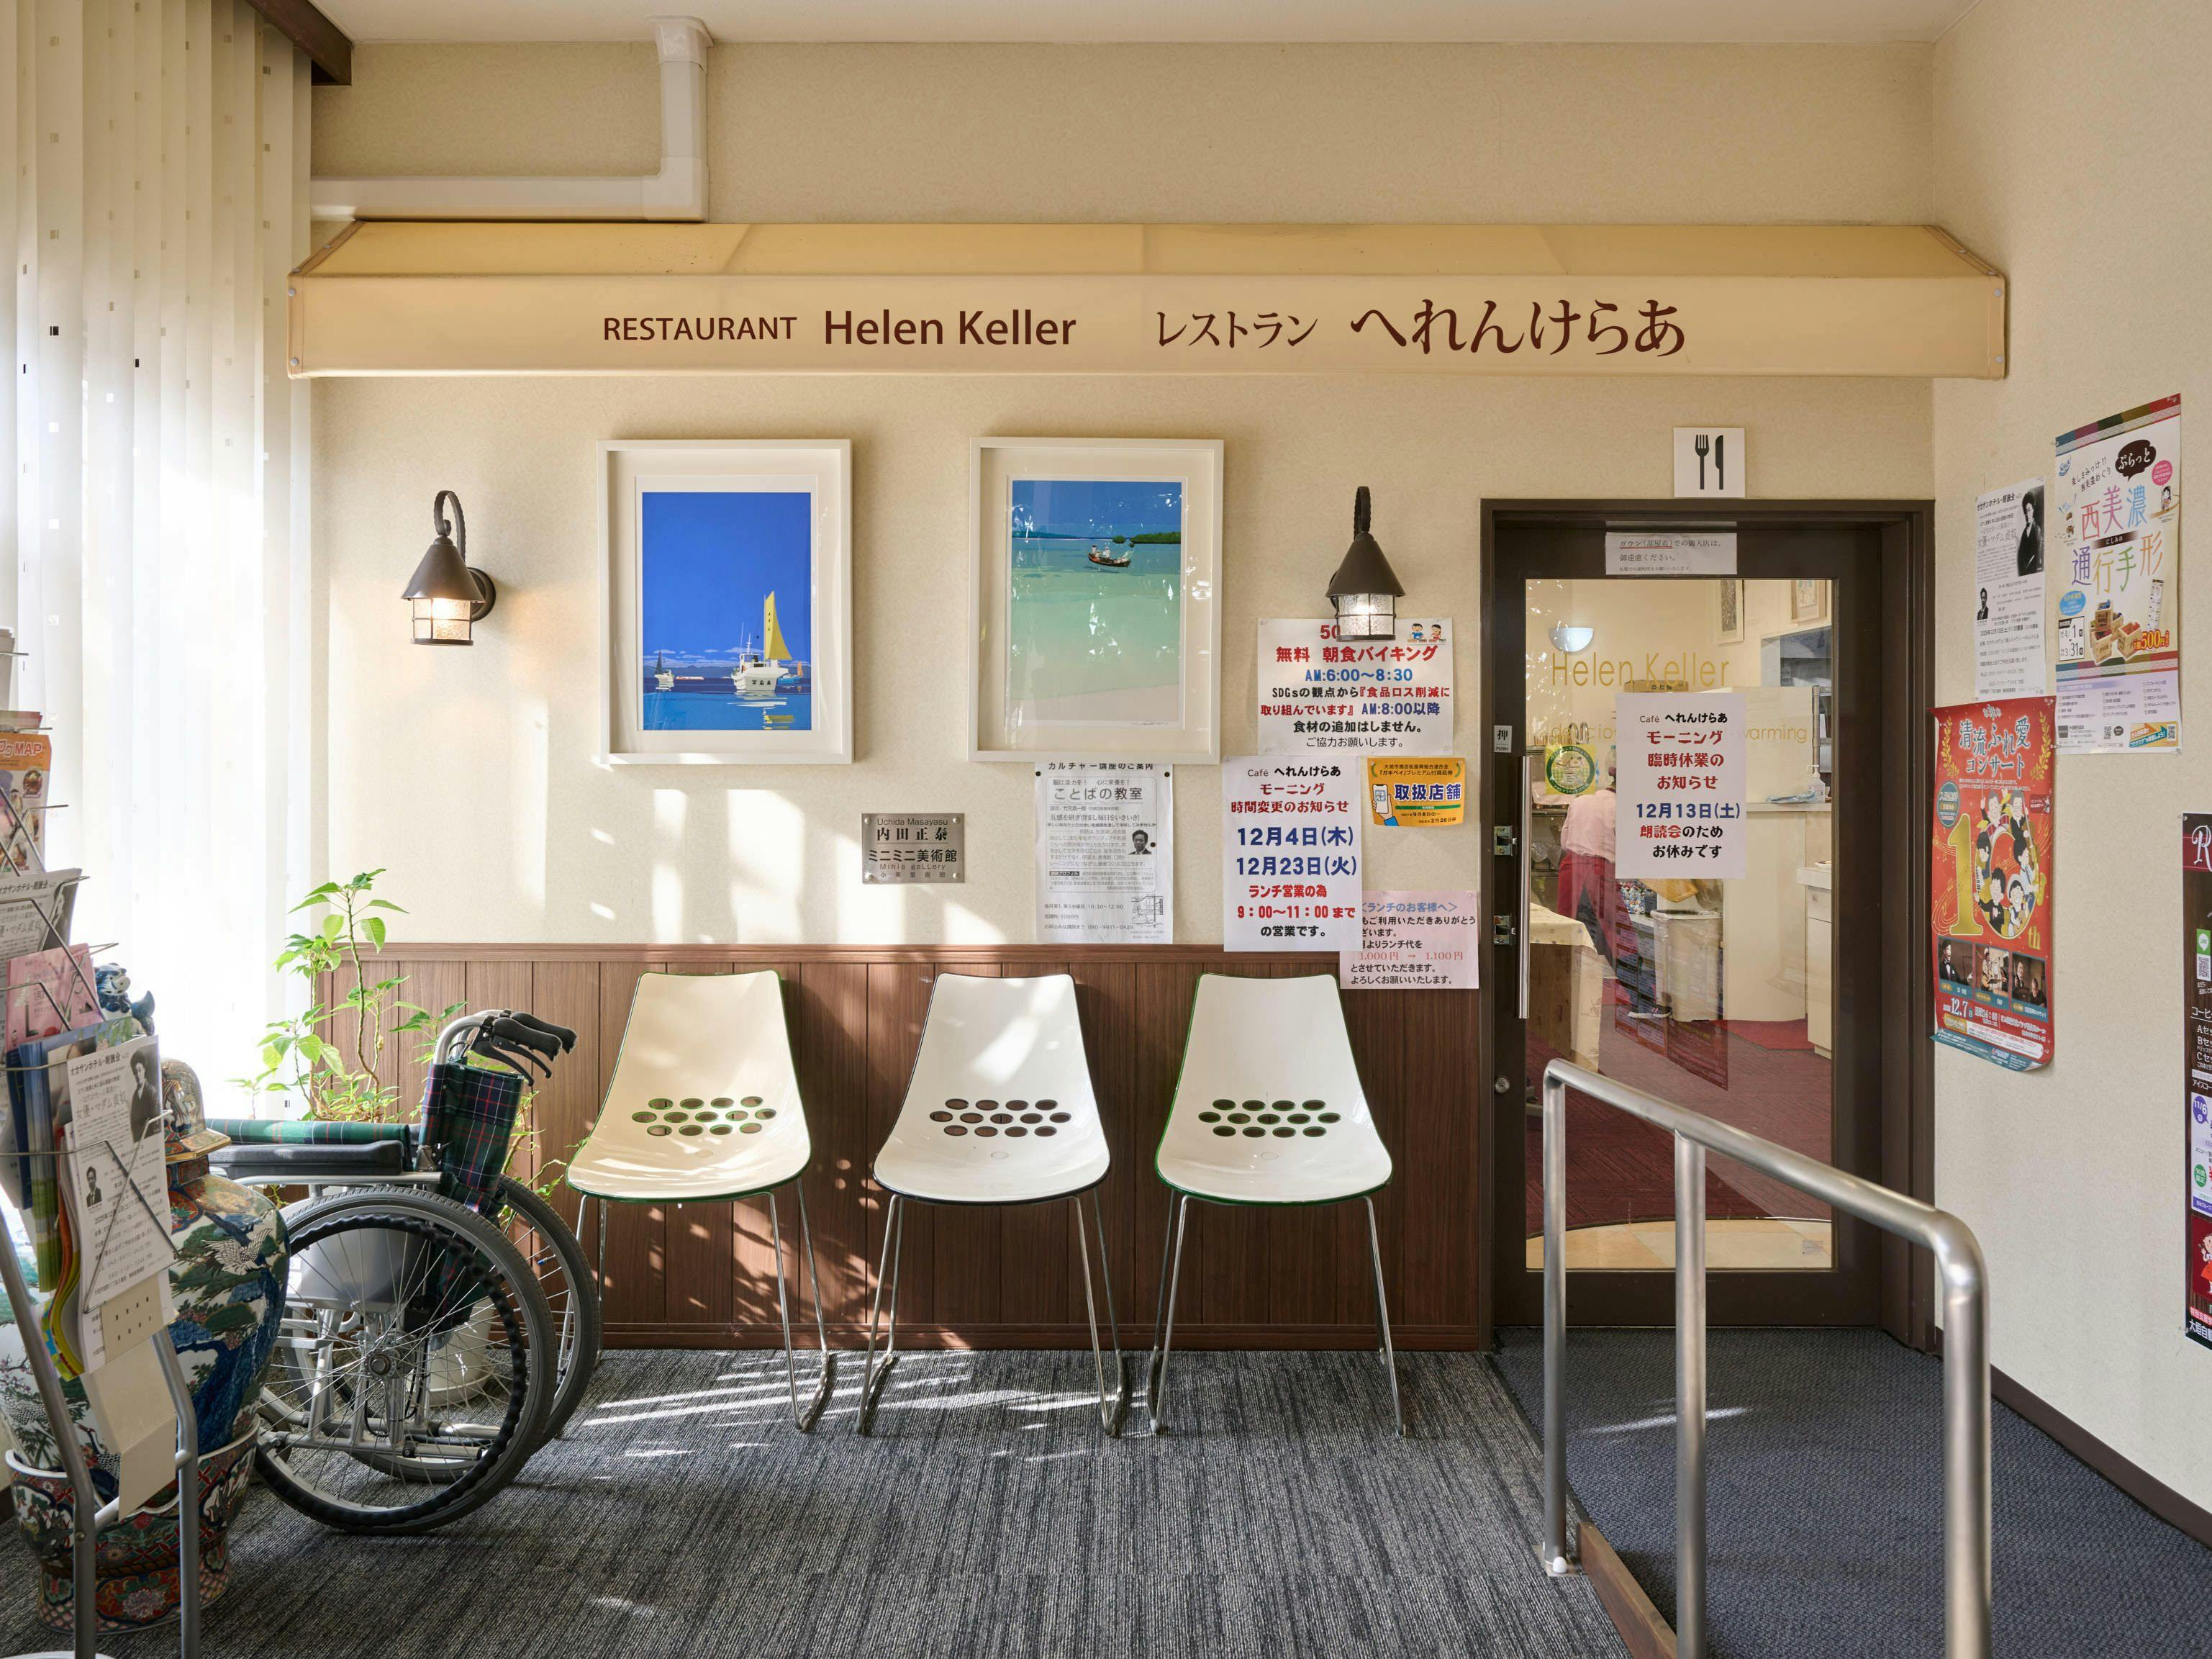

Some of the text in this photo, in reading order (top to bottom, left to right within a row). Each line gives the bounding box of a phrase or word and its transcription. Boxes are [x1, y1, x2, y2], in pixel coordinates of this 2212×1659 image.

[604, 309, 1077, 345] RESTAURANT Helen Keller
[1157, 299, 1685, 358] レストラン へれんけらあ
[2080, 485, 2148, 541] 西美濃
[2072, 530, 2163, 595] 通行手形
[1277, 645, 1438, 663] 無料 朝食バイキング
[1553, 652, 1729, 687] Helen Keller
[1272, 686, 1450, 698] SDGsの観点から『食品ロス削減に
[1665, 713, 1728, 723] へれんけらあ
[1293, 720, 1421, 733] 食材の追加はしません。
[1497, 729, 1508, 740] 押
[1647, 731, 1723, 745] モーニング
[1306, 737, 1403, 747] ご協力お願いします。
[1648, 753, 1724, 767] 臨時休業の
[1967, 754, 2025, 779] コンサート
[1274, 766, 1341, 777] へれんけらあ
[1260, 783, 1325, 795] モーニング
[1657, 775, 1718, 790] お知らせ
[1055, 787, 1143, 800] ことばの教室
[1395, 783, 1461, 801] 取扱店舗
[1231, 800, 1349, 813] 時間変更のお知らせ
[1636, 803, 1740, 819] 12月13日(土)
[877, 827, 948, 841] 内田正泰
[1238, 826, 1354, 846] 12月4日(木)
[1640, 825, 1723, 838] 朗読会のため
[869, 849, 957, 862] ミニミニ美術館
[1653, 844, 1722, 858] お休みです
[1236, 856, 1356, 875] 12月23日(火)
[1249, 885, 1327, 898] ランチ営業の為
[1261, 926, 1325, 937] の営業です。
[1351, 964, 1436, 972] とさせていただきます。
[1351, 975, 1452, 985] よろしくお願いいたします。
